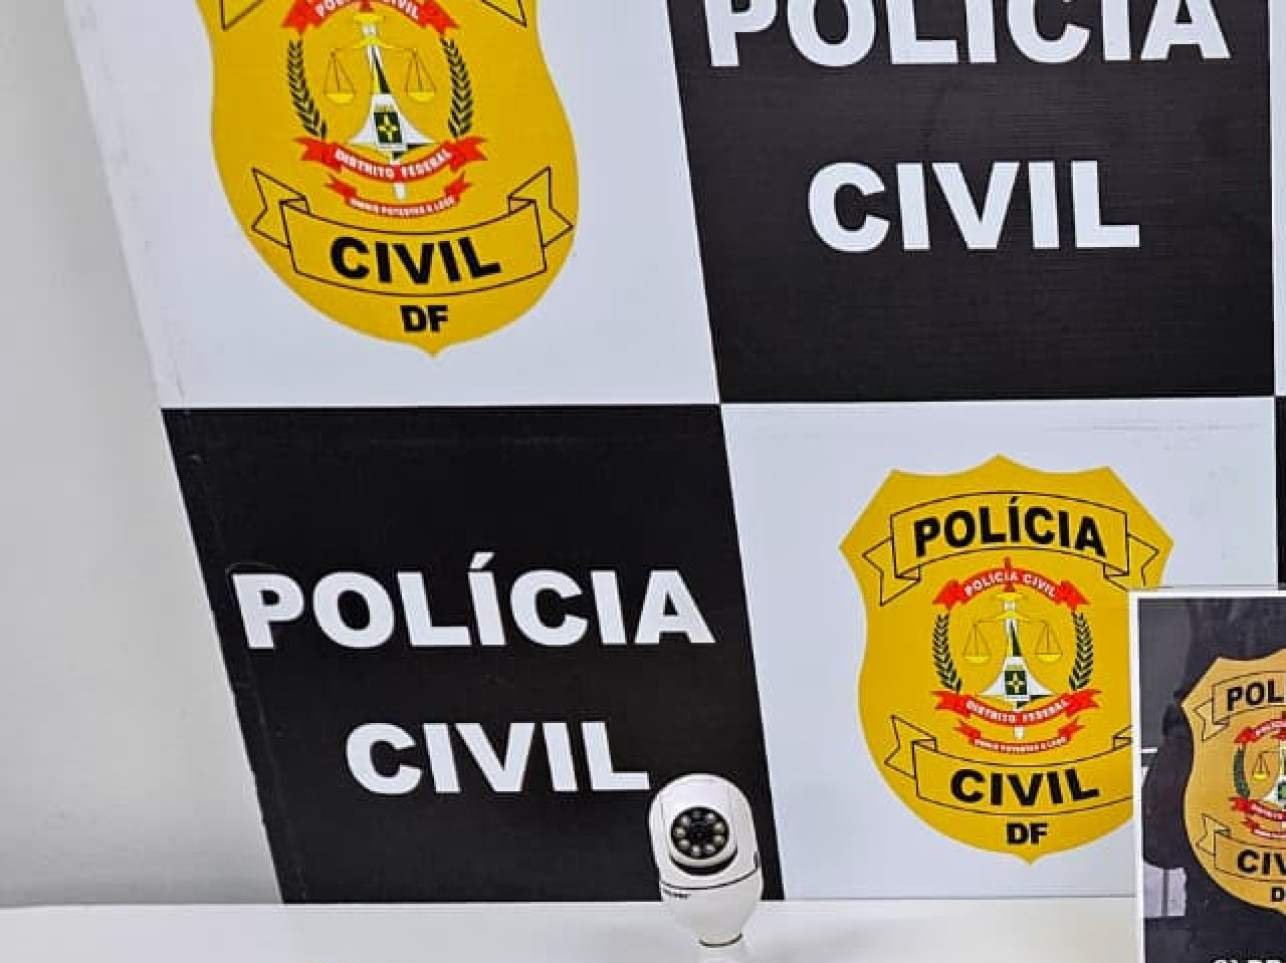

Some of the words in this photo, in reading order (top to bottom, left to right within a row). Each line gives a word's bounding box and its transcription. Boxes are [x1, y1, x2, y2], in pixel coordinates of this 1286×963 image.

[808, 161, 1140, 253] CIVIL
[330, 236, 502, 285] CIVIL
[400, 305, 449, 332] DF
[913, 496, 1107, 558] POLÍCIA
[231, 551, 716, 650] POLÍCIA
[345, 720, 650, 796] CIVIL
[950, 768, 1099, 806] CIVIL
[1006, 823, 1048, 845] DF
